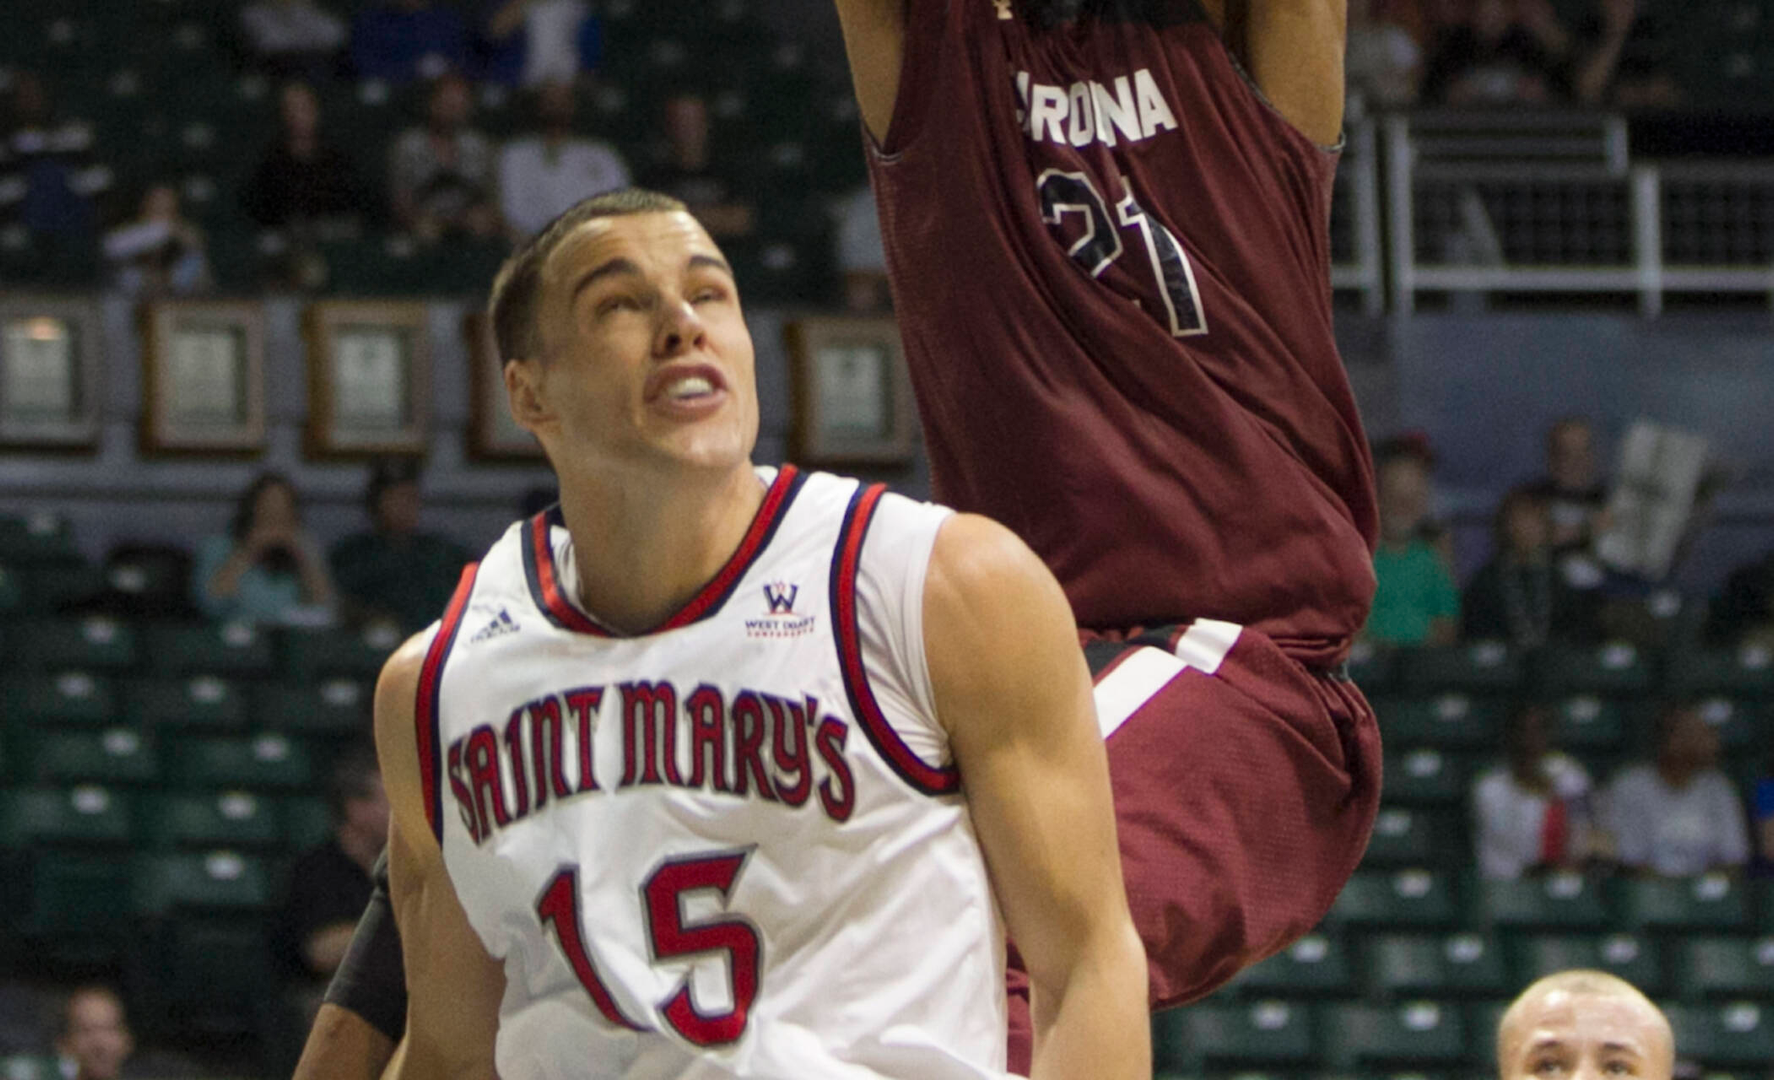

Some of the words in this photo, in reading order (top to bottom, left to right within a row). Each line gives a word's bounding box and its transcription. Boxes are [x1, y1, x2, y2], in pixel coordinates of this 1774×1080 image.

[450, 686, 604, 846] SAINT
[616, 680, 856, 823] MARY'S
[536, 844, 763, 1046] 15
